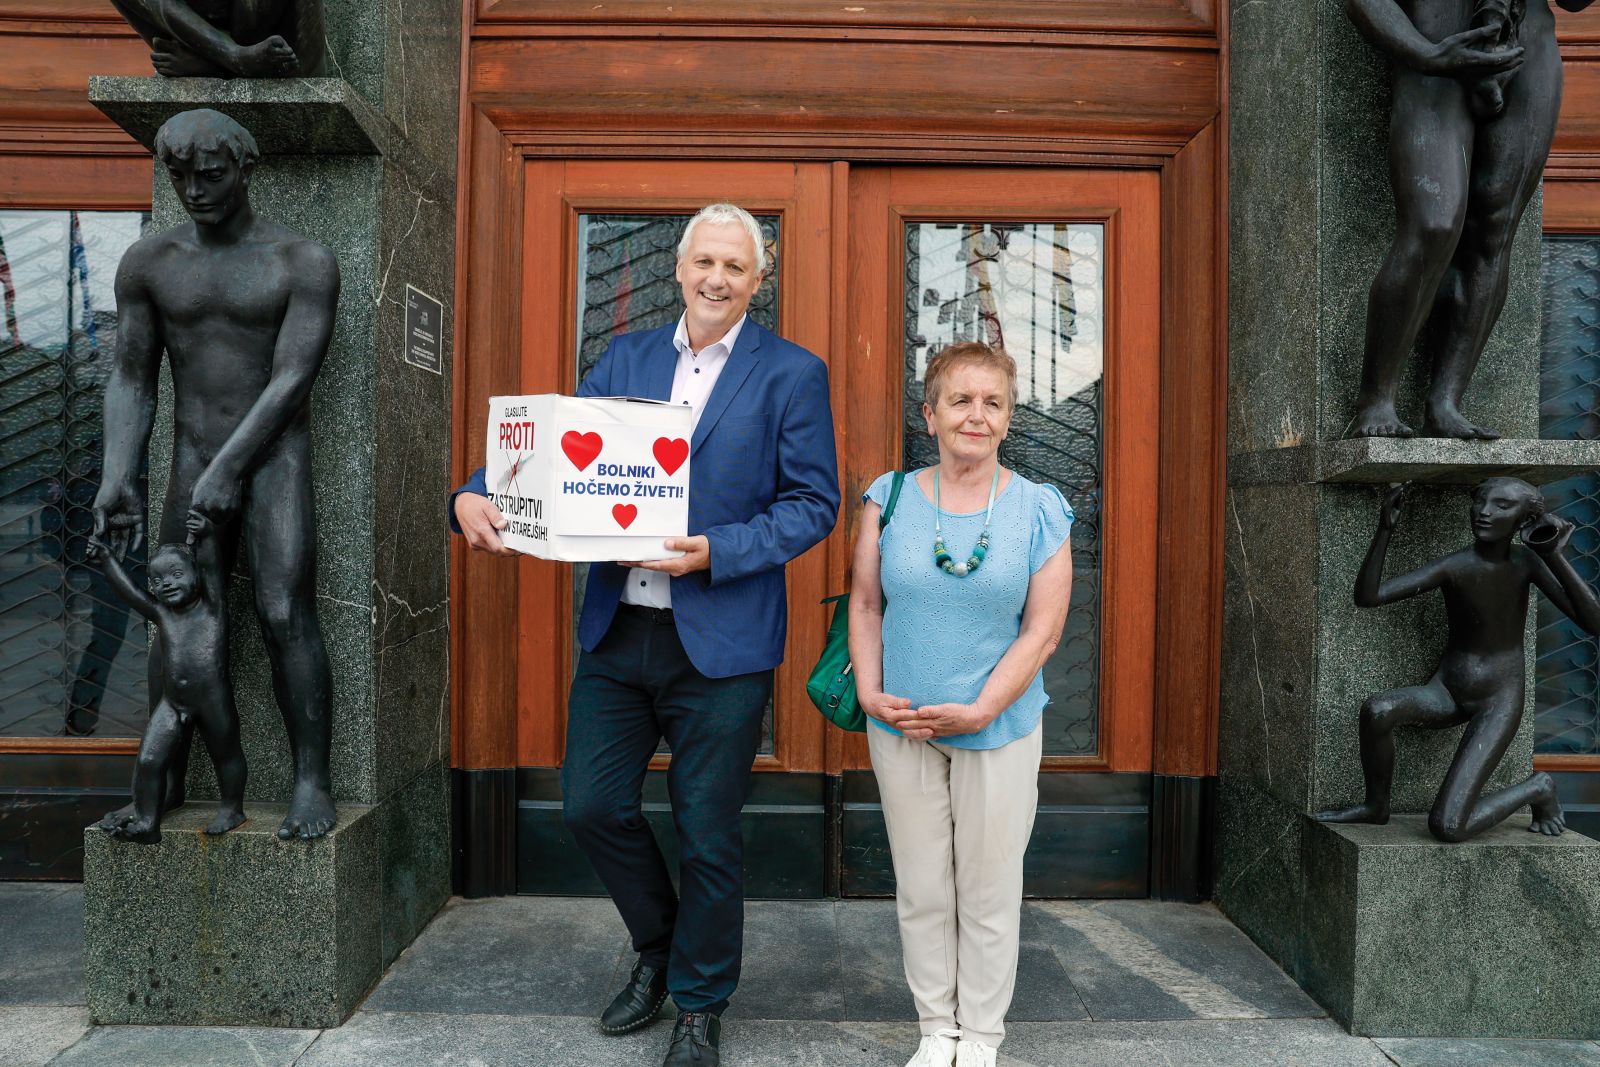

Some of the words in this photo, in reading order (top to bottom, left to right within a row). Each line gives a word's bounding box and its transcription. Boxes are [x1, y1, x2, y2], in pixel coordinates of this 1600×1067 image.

[504, 406, 527, 418] GLASUJTE
[499, 421, 535, 451] PROTI
[597, 463, 655, 479] BOLNIKI
[563, 478, 630, 497] HOČEMO
[633, 480, 684, 499] ŽIVETI!
[511, 520, 548, 541] STAREJŠIH!
